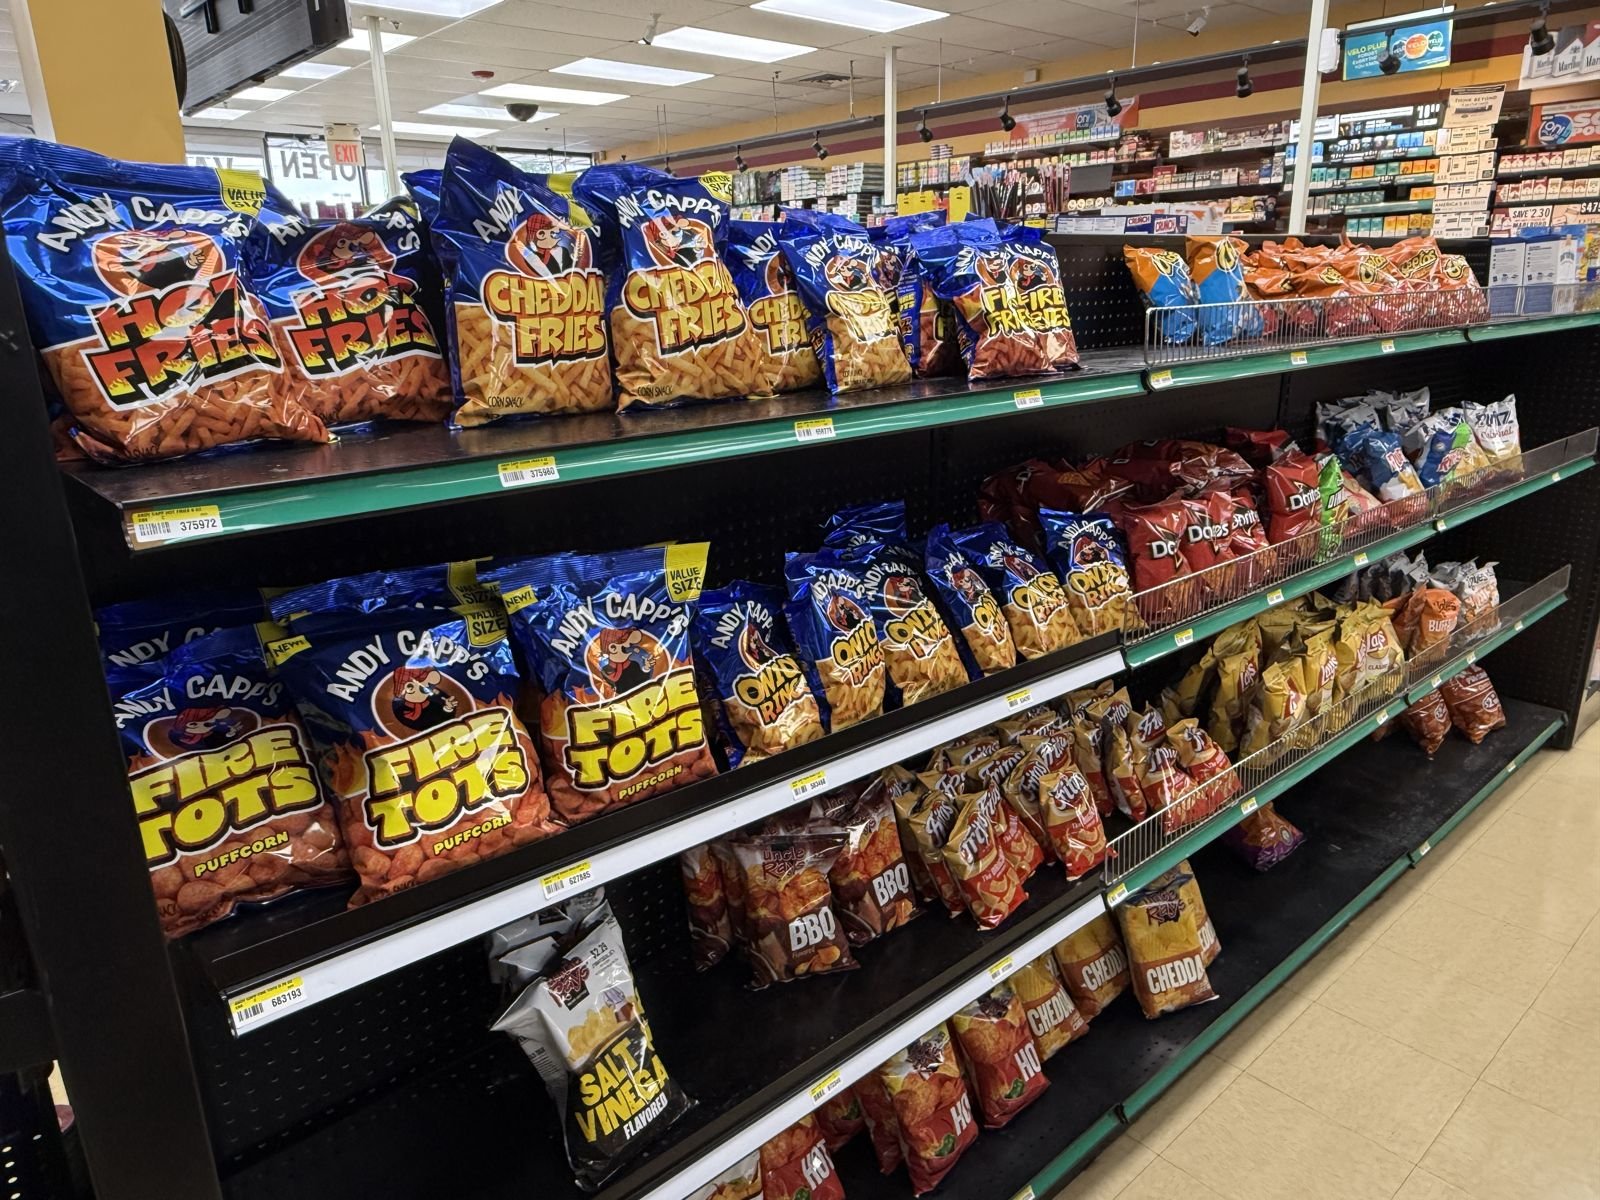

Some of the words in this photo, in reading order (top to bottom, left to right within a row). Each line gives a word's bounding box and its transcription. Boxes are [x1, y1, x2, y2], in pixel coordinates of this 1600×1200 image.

[1348, 46, 1366, 56] VELO
[1368, 40, 1387, 52] PLUS
[335, 144, 359, 162] EXIT
[36, 192, 122, 254] ANDY
[131, 196, 251, 238] CAPP'S
[268, 216, 304, 246] AN
[471, 185, 525, 244] ANDY
[645, 189, 723, 229] CAPP'S
[1128, 215, 1150, 226] CRUNCH
[1513, 209, 1528, 218] SAVE
[742, 226, 779, 273] ANDY
[1014, 243, 1060, 269] CAPP'S
[94, 271, 238, 347] HOT
[298, 274, 415, 328] HOT
[487, 270, 605, 316] CHEDDA
[293, 307, 436, 368] FRIES
[516, 315, 605, 355] FRIES
[659, 298, 746, 350] FRIES
[90, 317, 279, 397] FRIES
[529, 467, 556, 479] 375980
[179, 518, 218, 532] 375972
[1058, 519, 1079, 550] ANDY
[1078, 519, 1118, 551] CAPP'S
[668, 566, 702, 582] VALUE
[671, 576, 703, 596] SIZE
[470, 607, 503, 621] VALUE
[505, 593, 533, 609] NEW!
[472, 618, 507, 638] SIZE
[549, 595, 601, 659] ANDY
[604, 592, 690, 637] CAPP'S
[710, 601, 746, 650] ANDY
[108, 630, 171, 669] NDY
[326, 634, 392, 703] ANDY
[396, 629, 490, 682] CAPP'S
[113, 687, 178, 729] ANDY
[186, 674, 285, 707] CAPP'S
[571, 673, 699, 746] FIRE
[371, 712, 515, 795] FIRE
[569, 709, 703, 785] TOTS
[129, 729, 301, 815] FIRE
[372, 750, 528, 840] TOTS
[617, 764, 684, 801] PUFFCORN
[1053, 773, 1087, 811] Fritos
[138, 766, 318, 860] TOTS
[432, 812, 514, 857] PUFFCORN
[192, 831, 290, 879] PUFFCORN
[872, 862, 910, 908] BBQ
[788, 906, 837, 952] BBQ
[1146, 953, 1205, 995] CHEDDA
[271, 988, 303, 1008] 683193
[579, 1036, 639, 1107] SALT
[1013, 1042, 1042, 1083] HO
[575, 1054, 670, 1144] VINEGA
[622, 1092, 669, 1141] FLAVORED
[949, 1092, 972, 1136] HO
[801, 1138, 835, 1192] HOT
